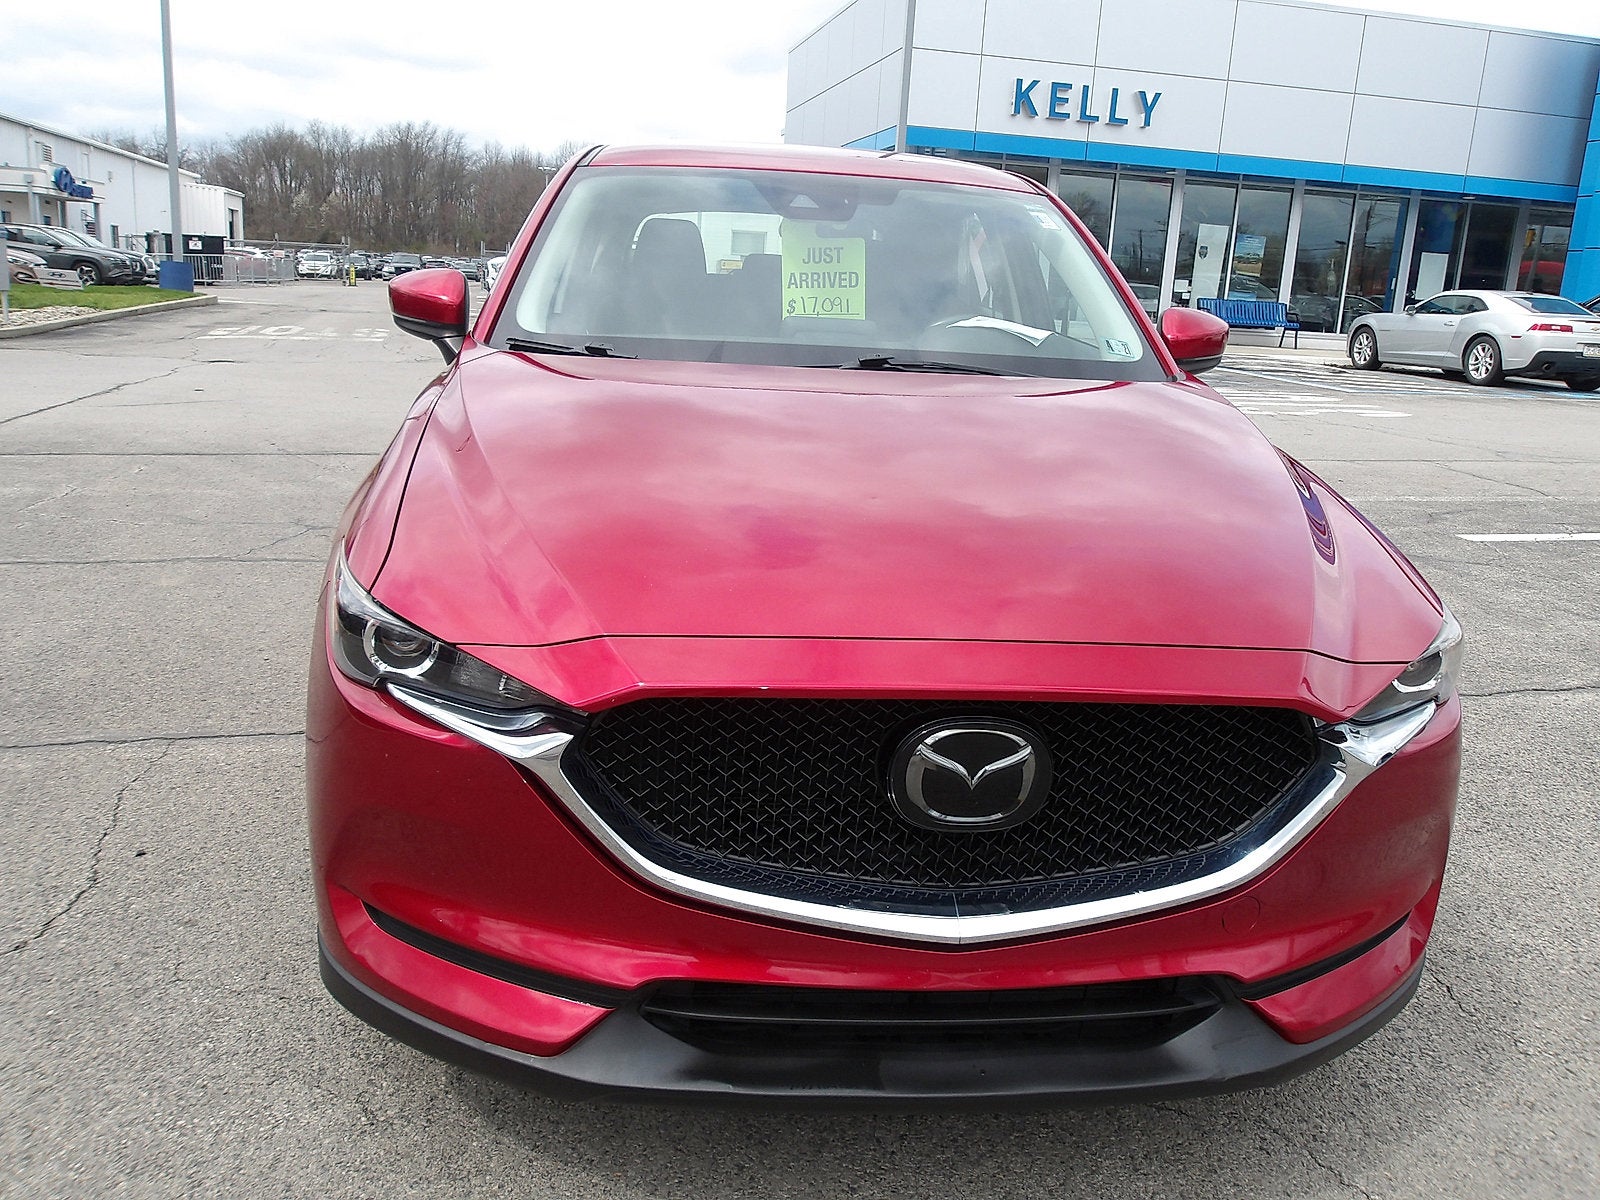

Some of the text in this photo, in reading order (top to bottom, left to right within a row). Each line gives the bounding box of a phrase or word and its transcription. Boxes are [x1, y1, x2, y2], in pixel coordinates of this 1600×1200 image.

[1012, 78, 1162, 128] KELLY
[802, 246, 844, 264] JUST
[787, 271, 859, 289] ARRIVED
